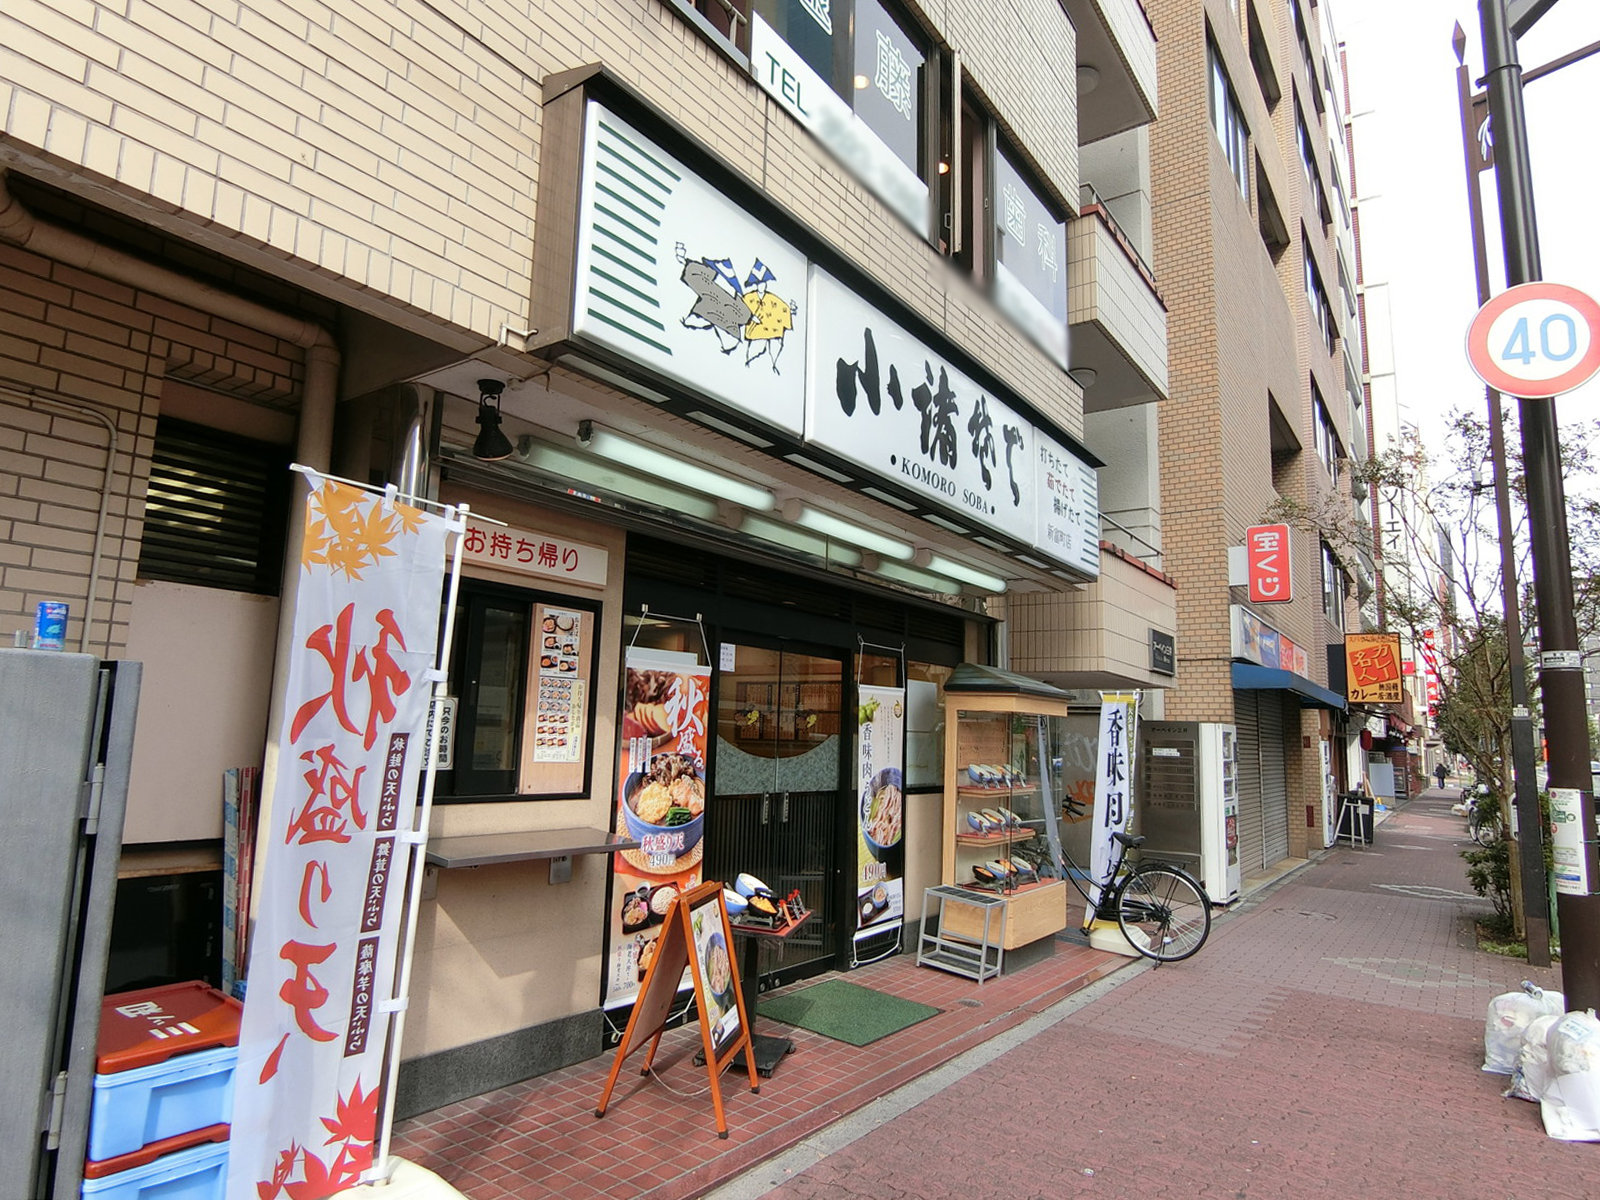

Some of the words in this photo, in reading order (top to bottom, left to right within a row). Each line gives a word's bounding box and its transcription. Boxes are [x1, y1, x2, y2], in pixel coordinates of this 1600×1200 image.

[765, 50, 810, 118] TEL
[1003, 183, 1058, 283] 歯科
[1501, 313, 1577, 365] 40
[1040, 445, 1069, 479] 打ちたて
[901, 457, 956, 497] KOMORO
[963, 489, 988, 514] SOBA
[1046, 471, 1075, 503] 茹でたて
[1053, 496, 1081, 527] 揚げたて
[464, 527, 578, 572] お持ち帰り
[1253, 532, 1280, 597] 宝くじ
[1353, 651, 1378, 681] 名人
[1370, 646, 1392, 680] カレー
[1351, 689, 1377, 700] カレー
[862, 723, 873, 829] 香味肉うどん
[643, 833, 684, 852] 秋盛り天
